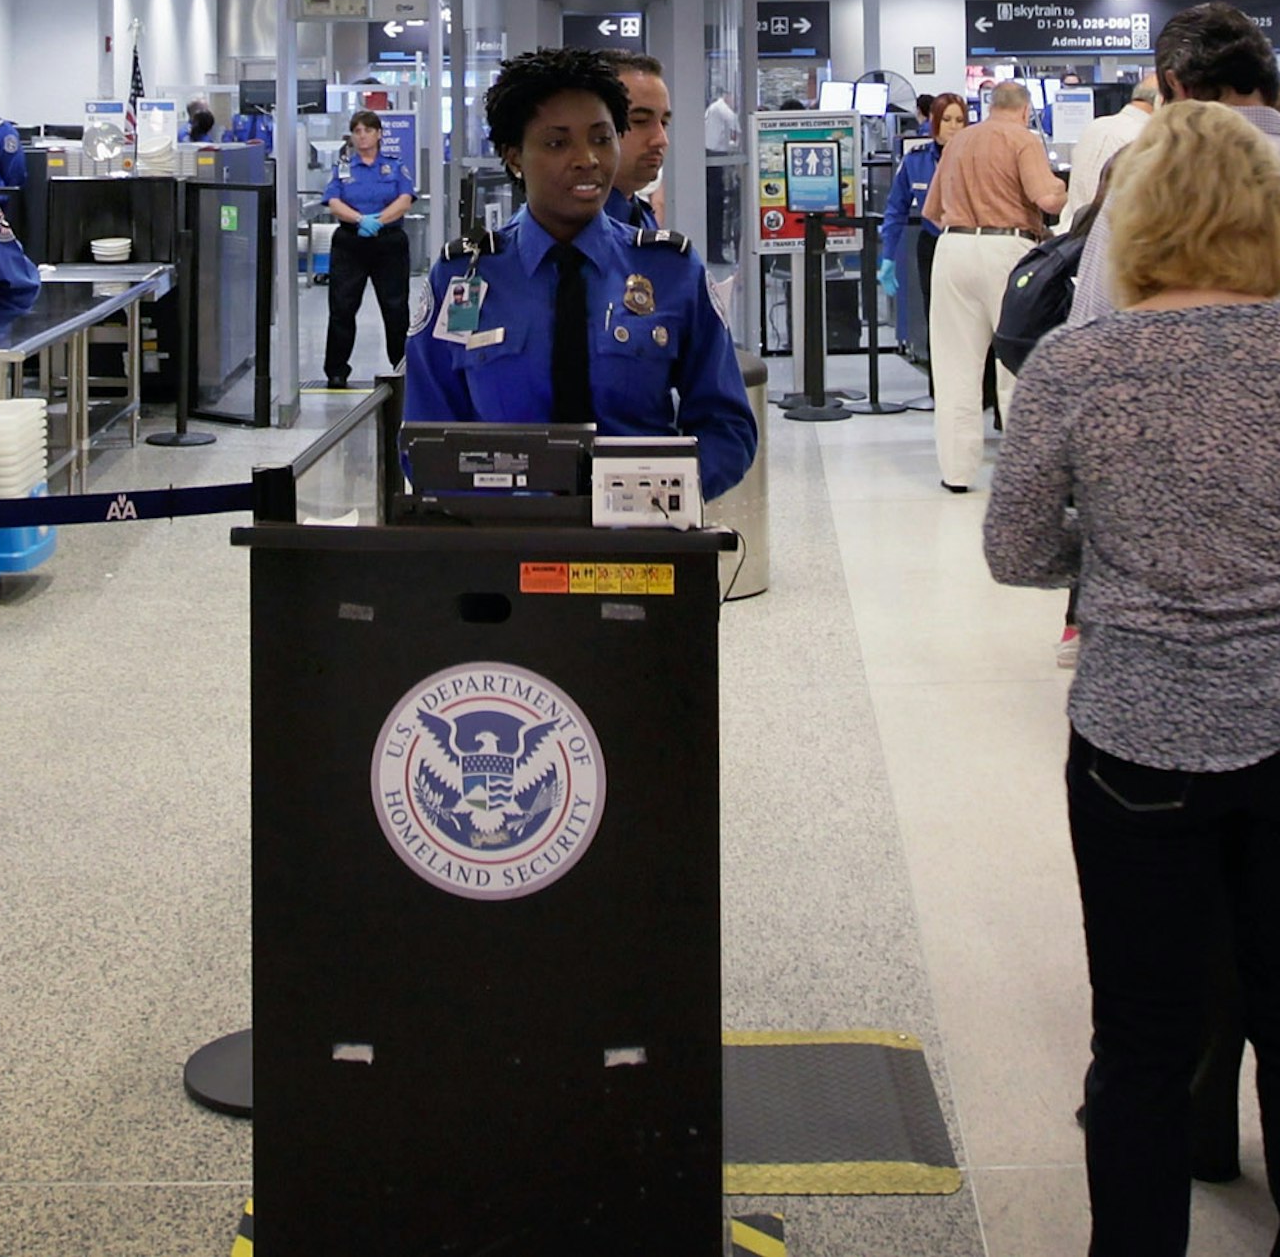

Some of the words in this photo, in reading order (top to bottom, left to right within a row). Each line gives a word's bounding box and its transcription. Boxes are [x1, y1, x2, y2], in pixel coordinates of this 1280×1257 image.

[1014, 4, 1061, 19] skytrain
[1063, 7, 1074, 16] to
[1052, 37, 1102, 47] Admirals
[1104, 36, 1131, 46] Club
[386, 723, 417, 758] U.S.
[421, 674, 576, 732] DEPARTMENT
[569, 736, 591, 767] OF
[385, 789, 490, 887] HOMELAND
[503, 794, 592, 887] SECURITY
